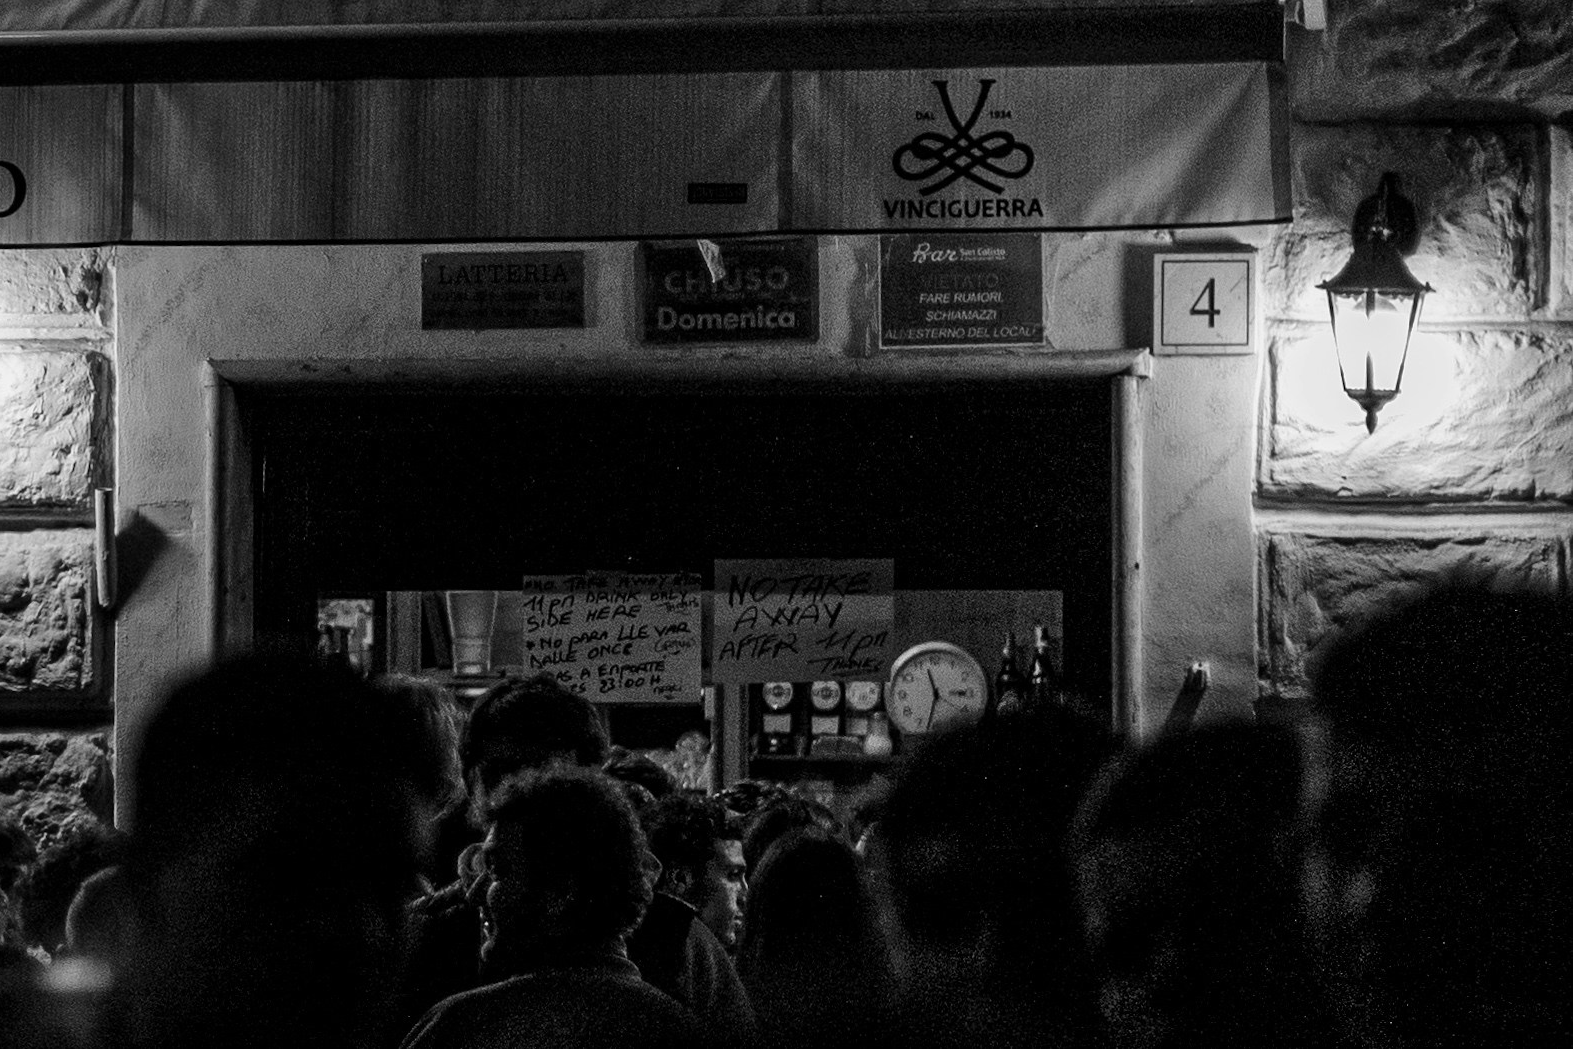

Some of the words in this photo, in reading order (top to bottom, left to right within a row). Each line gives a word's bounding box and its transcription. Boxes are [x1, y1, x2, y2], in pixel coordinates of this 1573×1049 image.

[915, 111, 936, 121] DAL
[989, 110, 1012, 120] 1934
[882, 197, 1044, 220] VINCIGUERRA
[912, 241, 958, 264] Bar
[437, 262, 569, 285] LATTERIA
[919, 292, 951, 304] FARE
[1188, 277, 1221, 329] 4
[657, 304, 795, 331] Domenica
[925, 309, 998, 322] SCHIAMAZZI
[968, 326, 991, 339] DEL
[586, 590, 641, 604] DRINK
[729, 575, 778, 608] NO
[780, 572, 871, 604] TAKE
[527, 611, 572, 632] SIDE
[587, 604, 642, 622] HERE
[733, 602, 842, 632] AWAY
[588, 643, 633, 661] ONCE
[719, 633, 799, 661] AFTER
